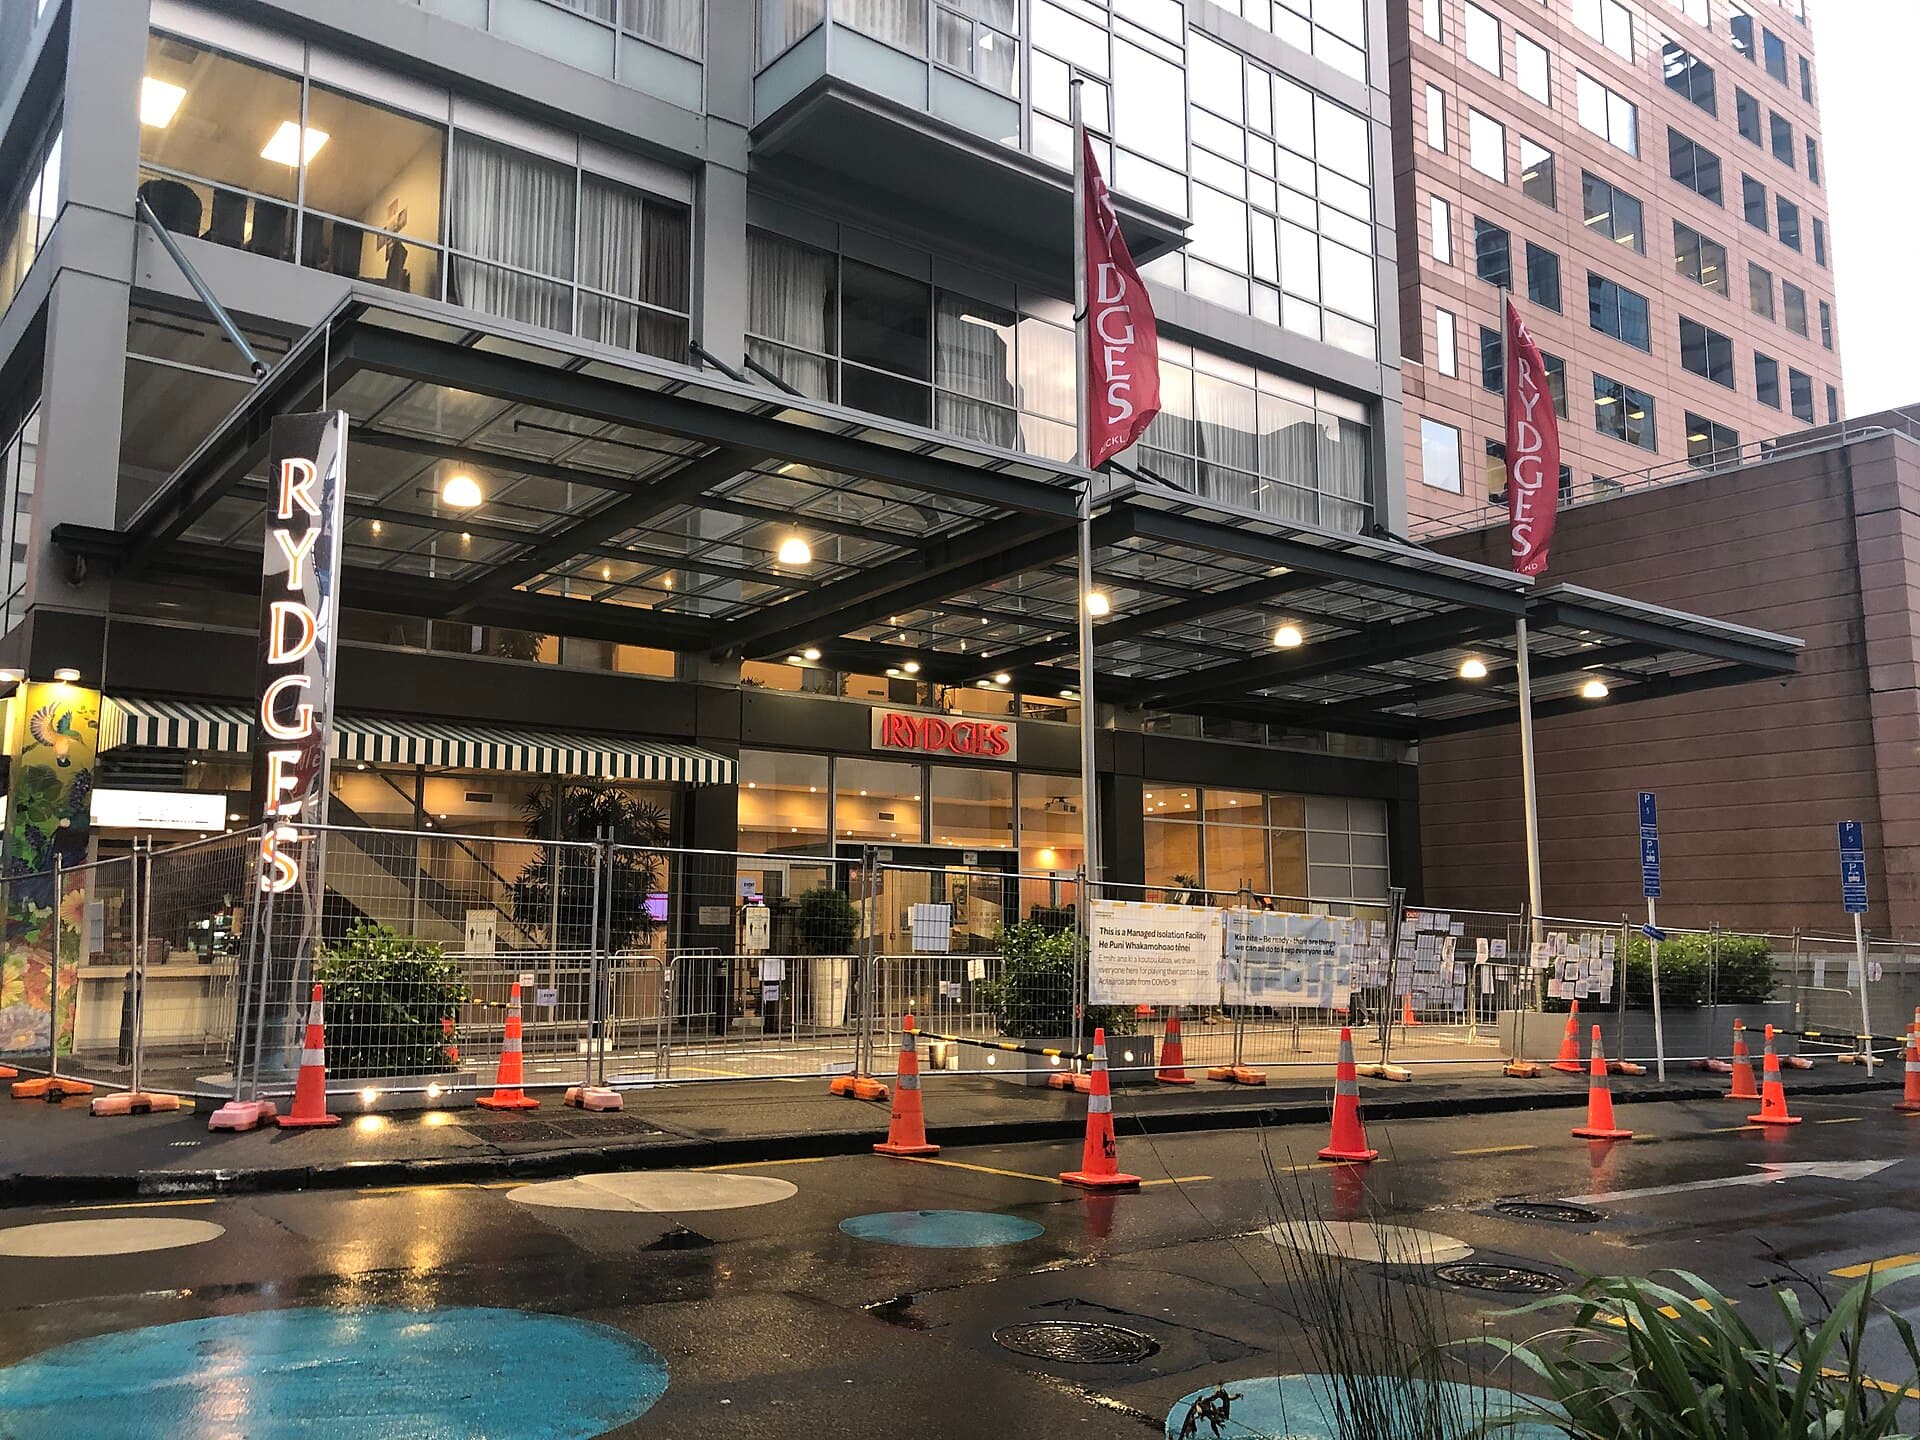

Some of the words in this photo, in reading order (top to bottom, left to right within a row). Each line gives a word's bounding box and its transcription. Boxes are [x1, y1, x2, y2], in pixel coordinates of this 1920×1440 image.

[1512, 357, 1543, 556] RYDGES
[262, 457, 321, 893] RYDGES
[882, 713, 1010, 756] RYDGES
[1645, 794, 1650, 803] P
[1846, 823, 1854, 831] P
[1647, 841, 1652, 849] P
[1100, 927, 1114, 936] This
[1115, 928, 1120, 936] is
[1127, 928, 1156, 939] Managed
[1157, 930, 1184, 939] Isolation
[1186, 932, 1206, 942] Facility
[1099, 940, 1108, 948] He
[1110, 941, 1124, 949] Puni
[1319, 938, 1336, 948] things
[1246, 944, 1256, 952] can
[1323, 948, 1335, 956] safe
